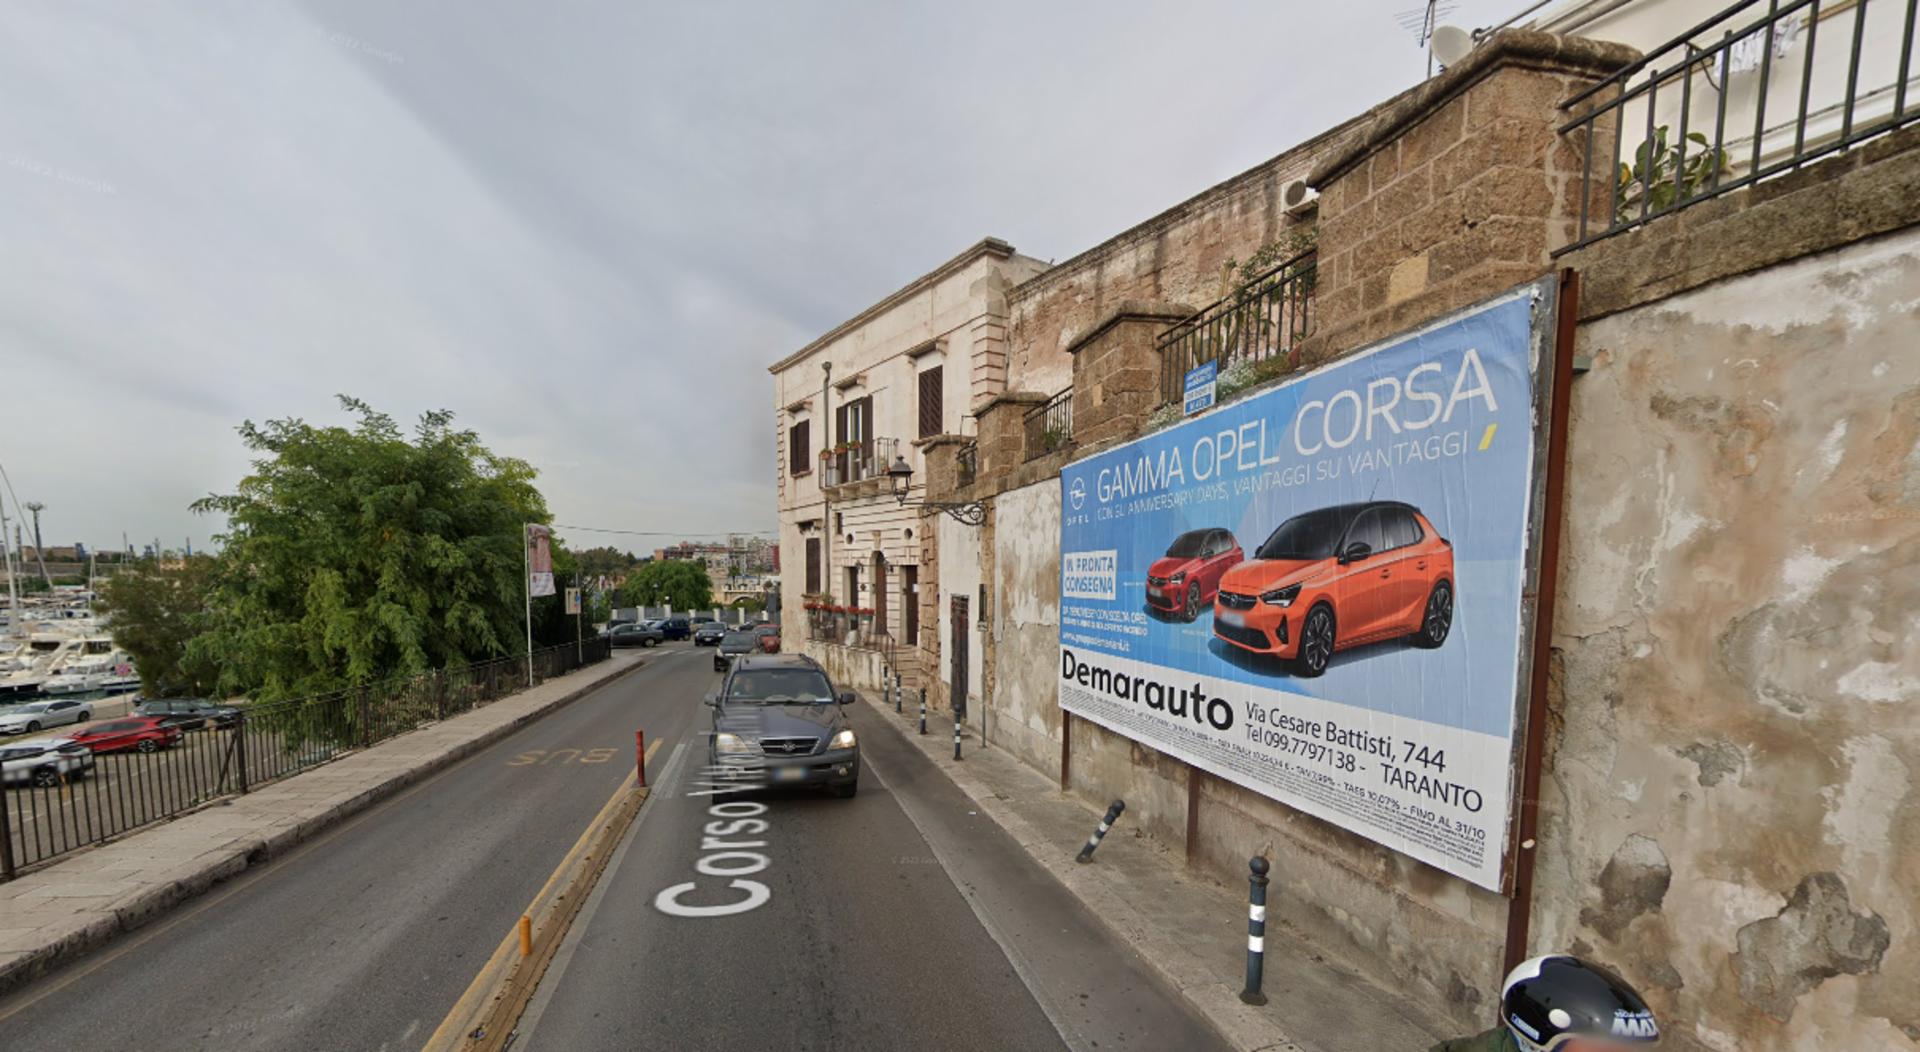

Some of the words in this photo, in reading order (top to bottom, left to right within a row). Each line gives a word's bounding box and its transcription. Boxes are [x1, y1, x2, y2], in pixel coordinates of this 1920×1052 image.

[1097, 447, 1185, 503] GAMMA
[1192, 418, 1280, 480] OPEL
[1294, 348, 1498, 456] CORSA
[1234, 464, 1311, 496] VANTAGGI
[1316, 458, 1341, 481] SU
[1348, 430, 1468, 474] VANTAGGI
[1065, 576, 1113, 594] CONSEGNA
[1062, 649, 1234, 731] Demarauto
[1245, 701, 1265, 723] Via
[1269, 707, 1321, 739] Cesare
[1326, 721, 1396, 763] Battisti,
[1403, 740, 1446, 773] 744
[1245, 722, 1263, 743] Tel
[1264, 730, 1356, 772] 099.7797138
[1380, 762, 1483, 812] TARANTO
[1409, 805, 1436, 822] FINO
[1438, 815, 1452, 829] AL
[1454, 821, 1486, 841] 31/10
